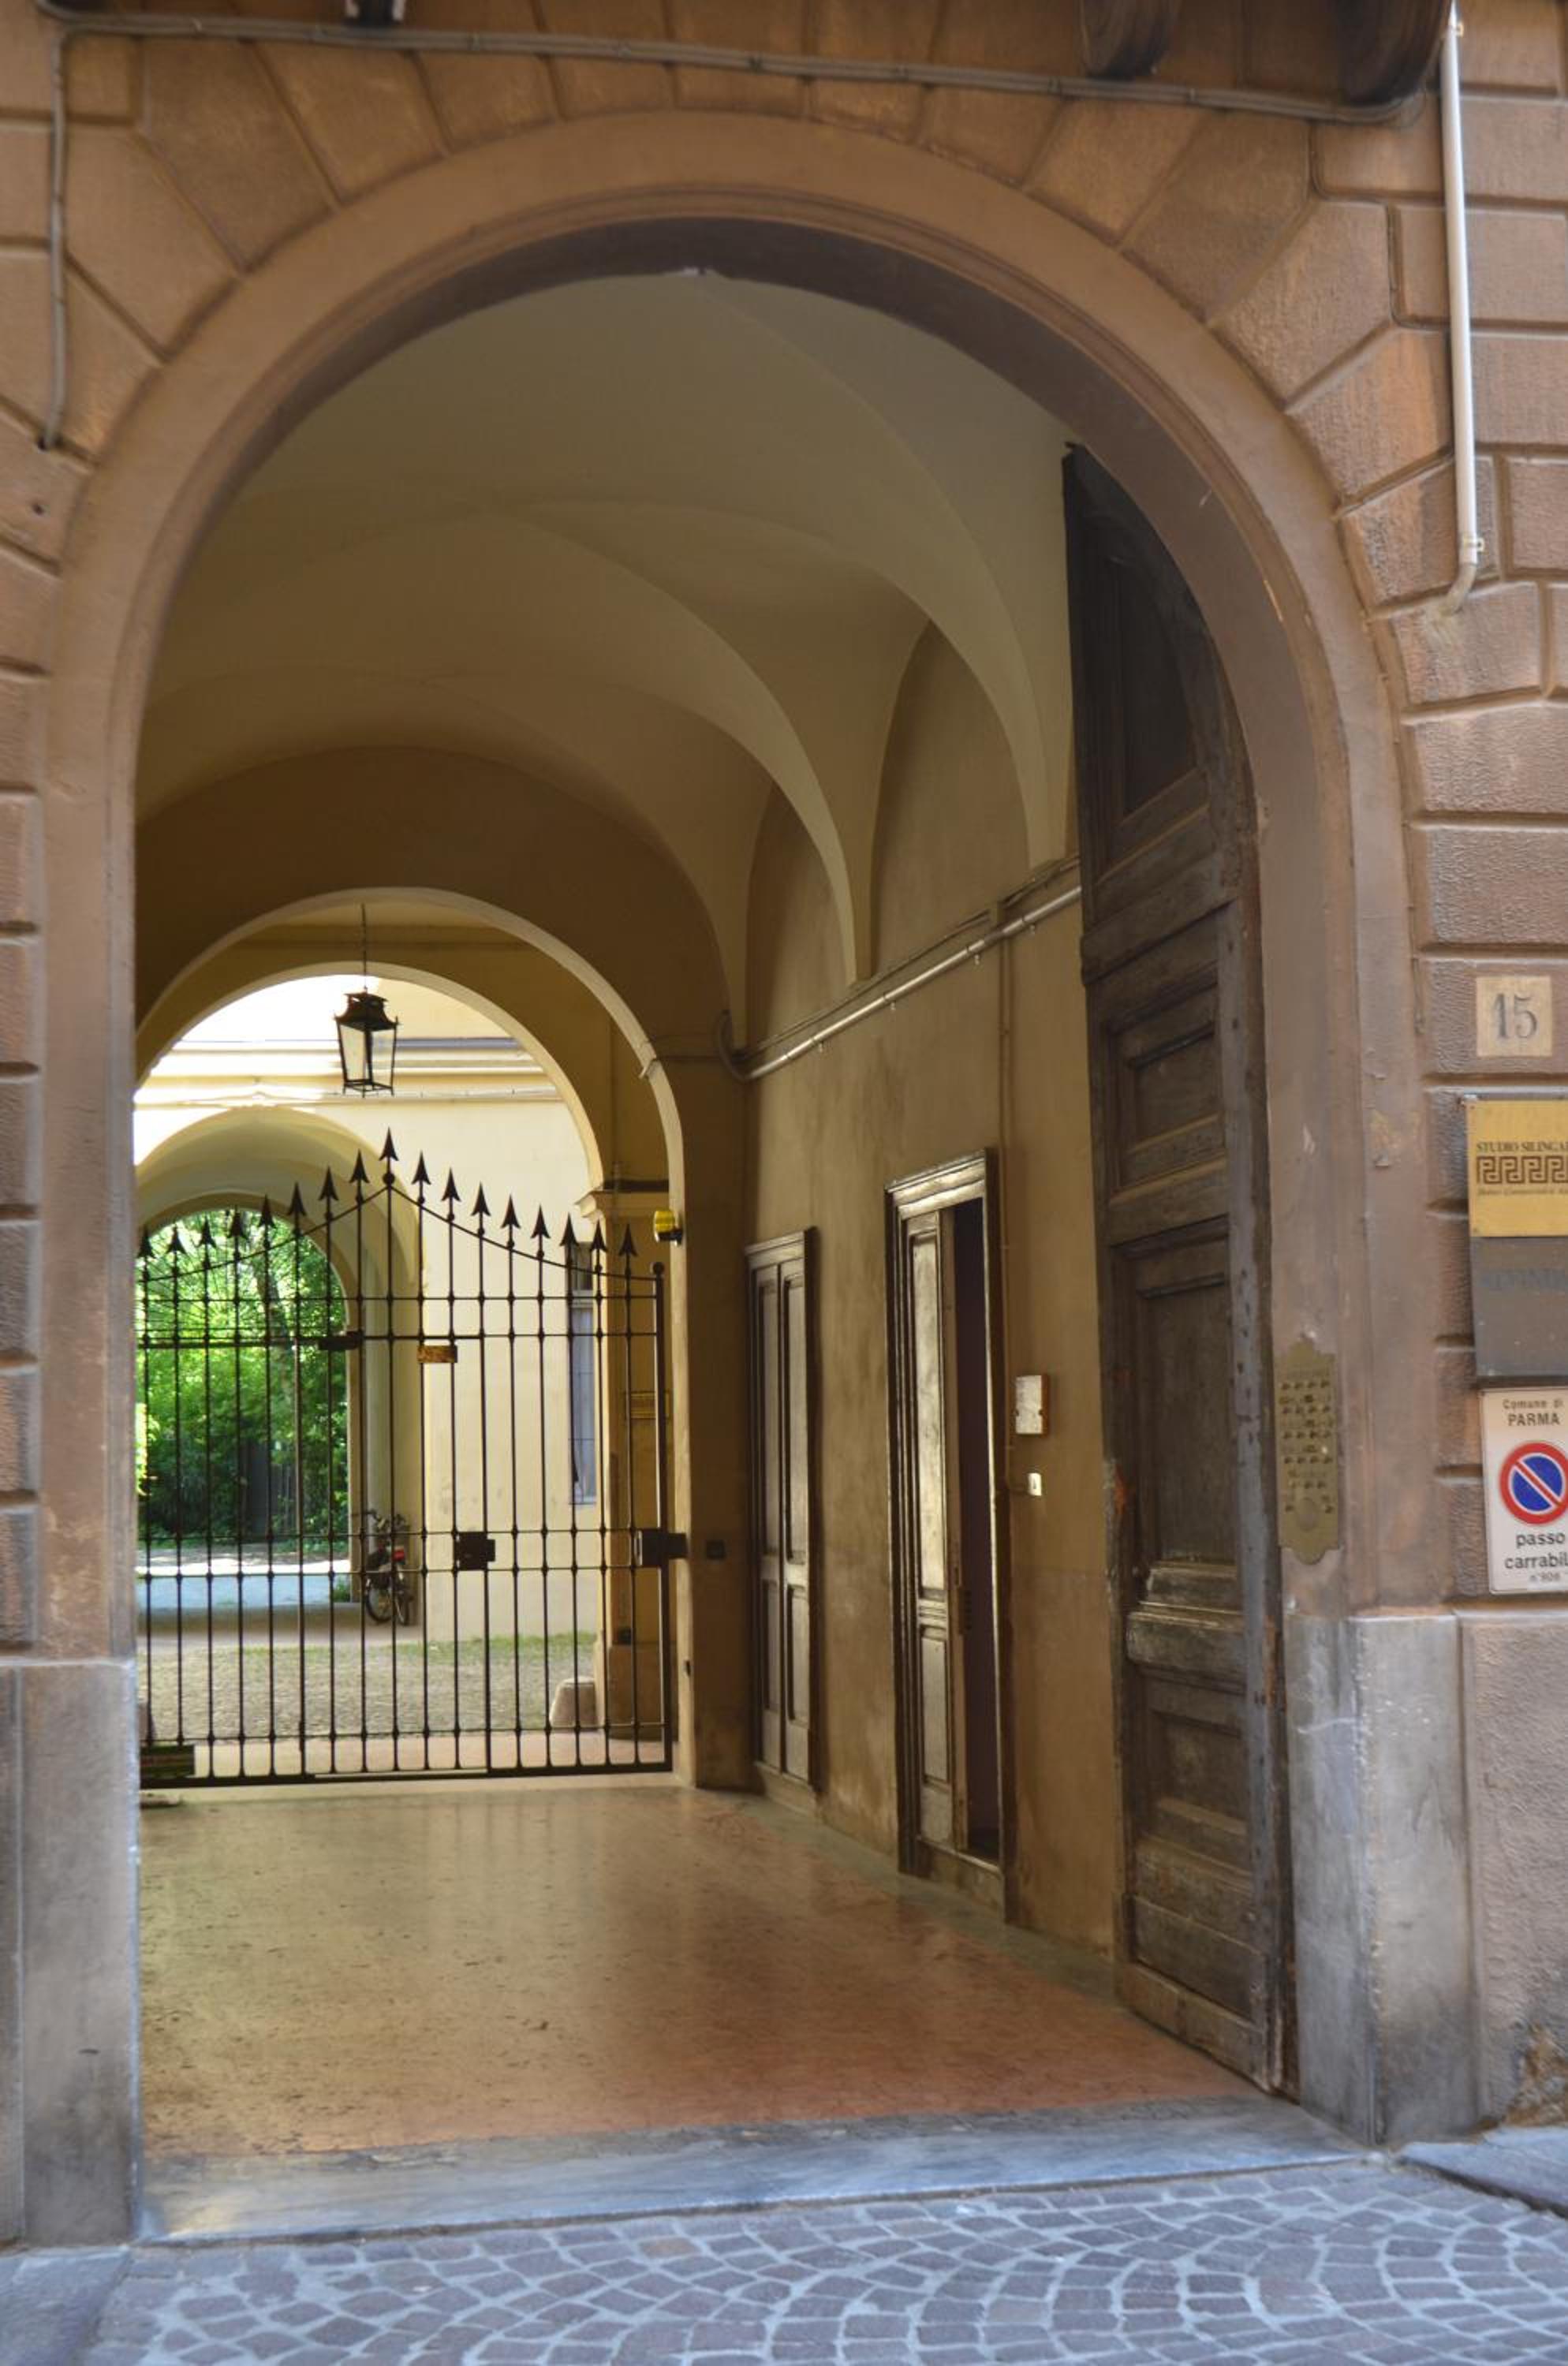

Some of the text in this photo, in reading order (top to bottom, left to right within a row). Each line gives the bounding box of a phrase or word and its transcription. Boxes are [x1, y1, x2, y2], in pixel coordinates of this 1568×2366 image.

[1490, 993, 1537, 1040] 15
[1476, 1141, 1519, 1152] STUDIO
[1502, 1398, 1564, 1409] Comune di
[1508, 1413, 1561, 1426] PARMA
[1516, 1532, 1566, 1549] passo
[1504, 1551, 1568, 1569] carrabil
